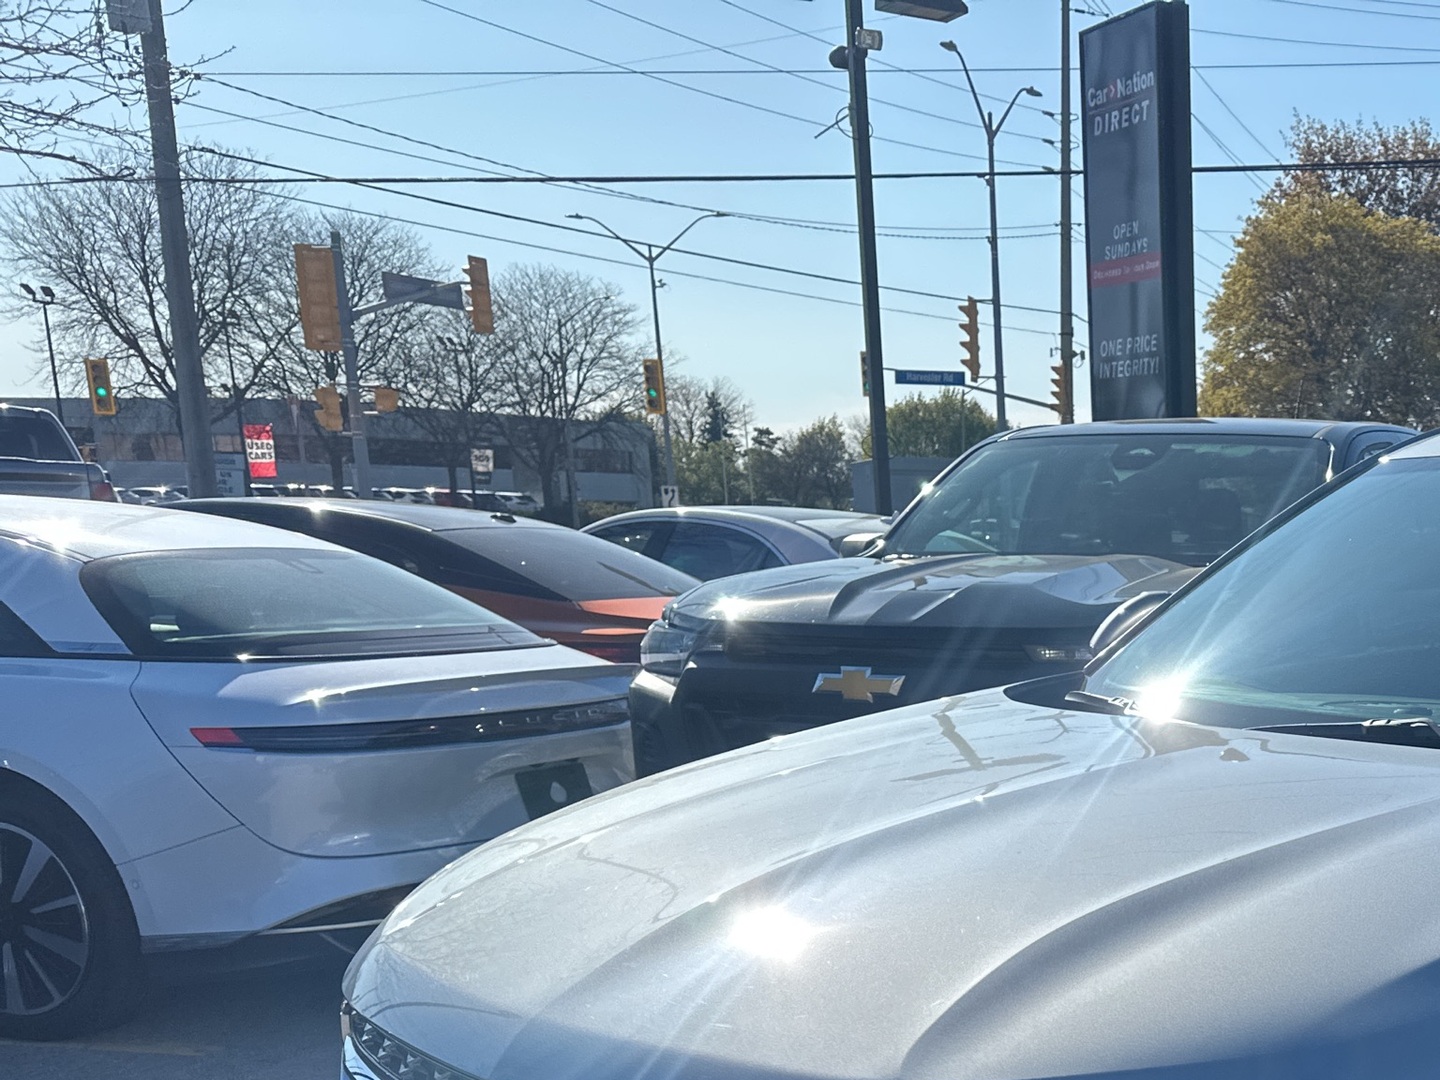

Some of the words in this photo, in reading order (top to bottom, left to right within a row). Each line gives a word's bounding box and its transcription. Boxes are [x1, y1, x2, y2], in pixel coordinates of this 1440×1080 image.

[1094, 100, 1150, 136] DIRECT
[1113, 220, 1139, 240] OPEN
[1104, 237, 1148, 260] SUNDAYS
[1100, 338, 1123, 357] ONE
[1126, 333, 1158, 355] PRICE
[1099, 355, 1160, 379] INTEGRITY!
[247, 441, 273, 451] USED
[248, 451, 273, 461] CARS
